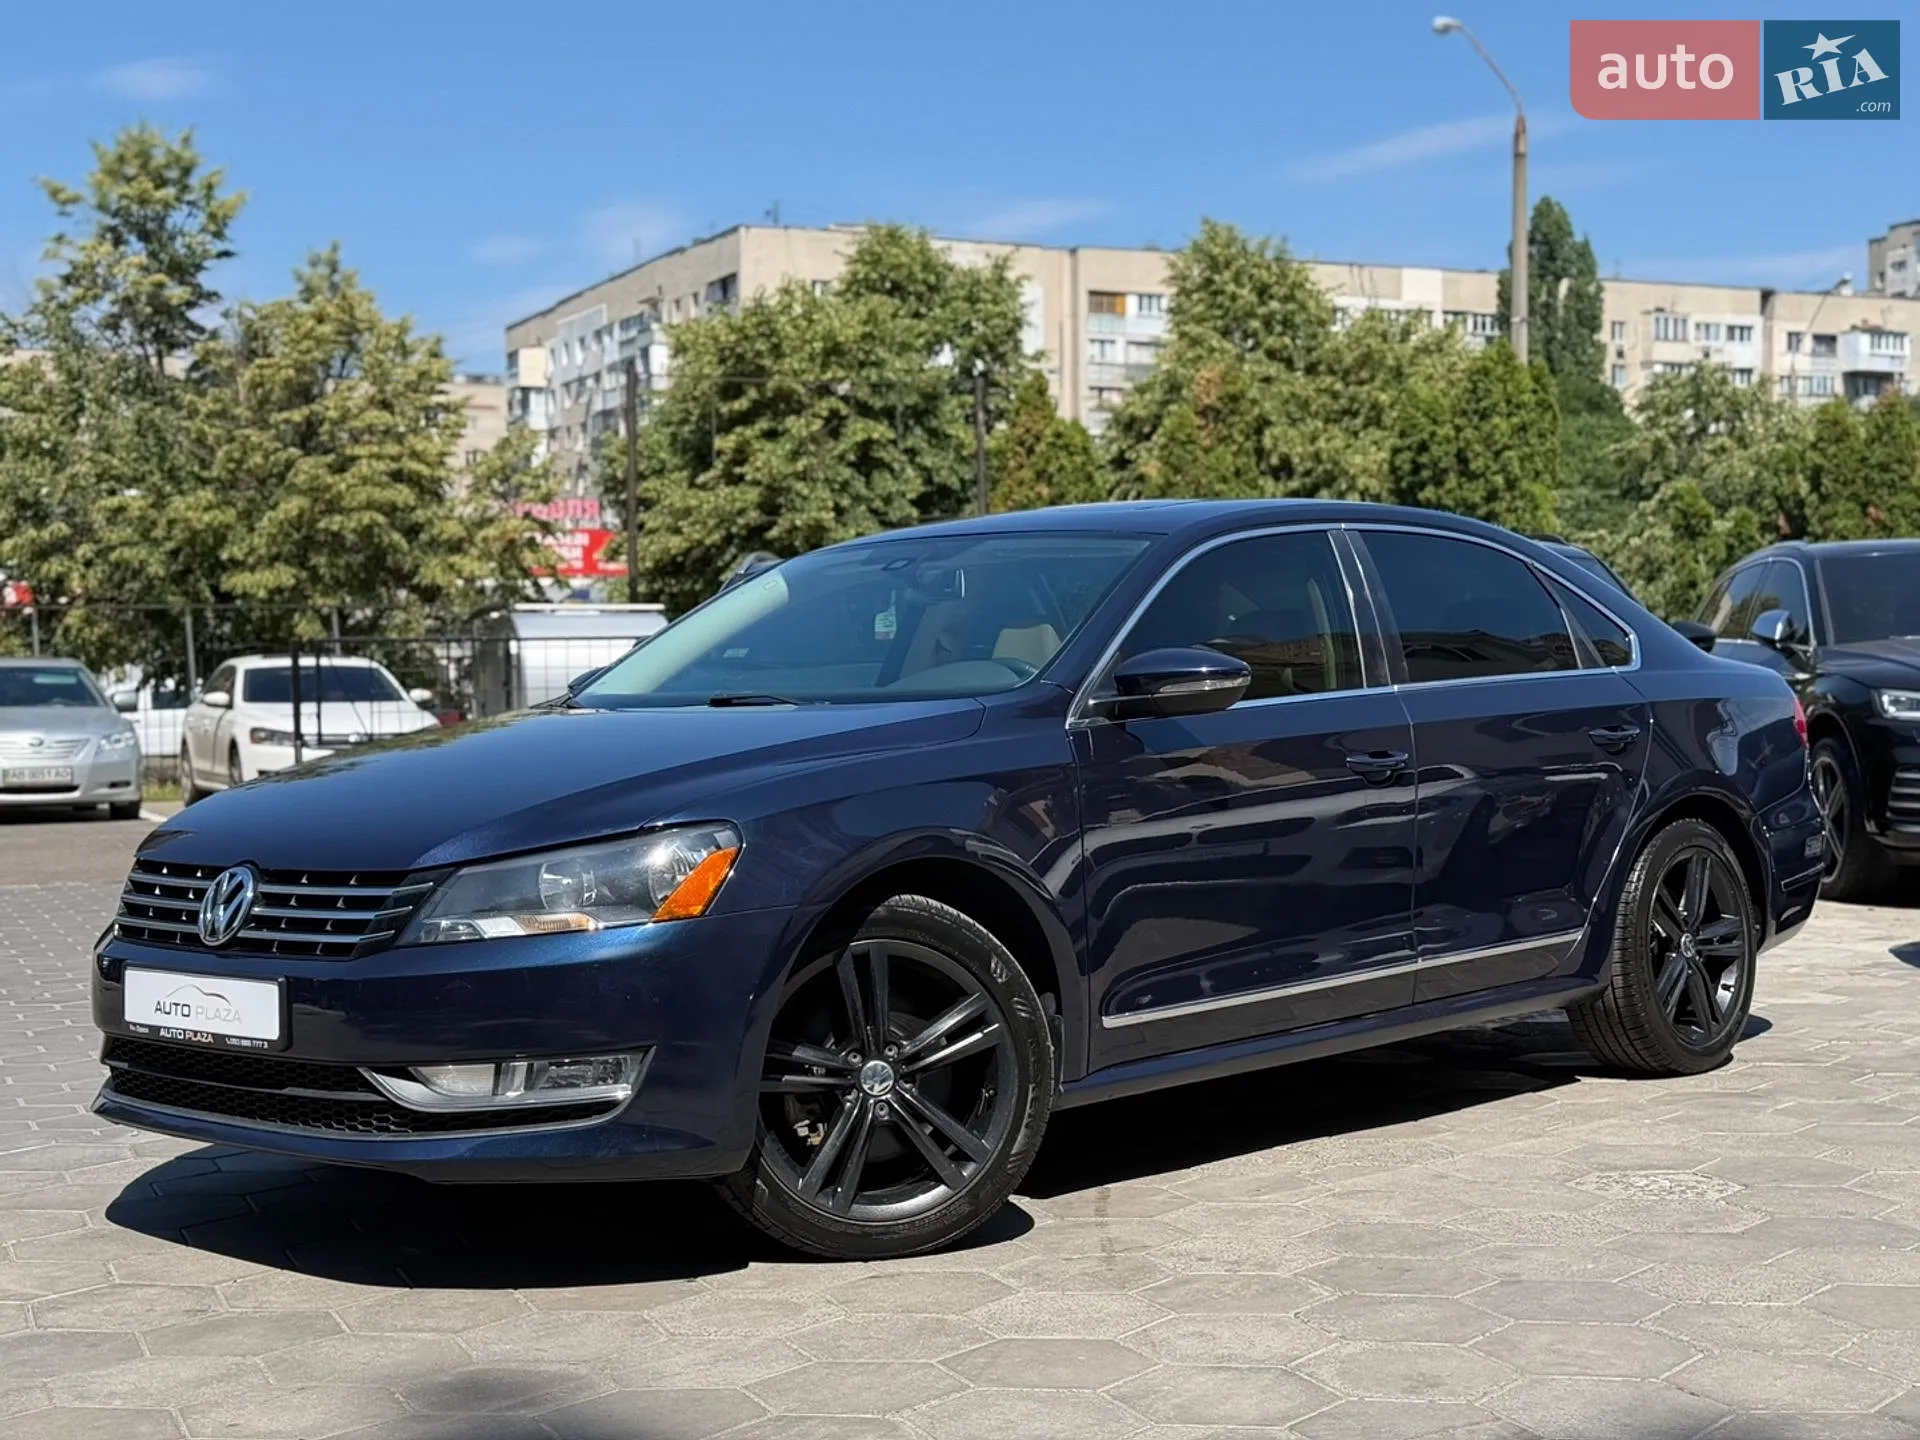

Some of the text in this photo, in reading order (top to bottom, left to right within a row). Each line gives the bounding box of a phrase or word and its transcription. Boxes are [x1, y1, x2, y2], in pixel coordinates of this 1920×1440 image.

[154, 1000, 242, 1024] AUTO PLAZA
[159, 1026, 184, 1040] AUTO
[185, 1030, 214, 1044] PLAZA
